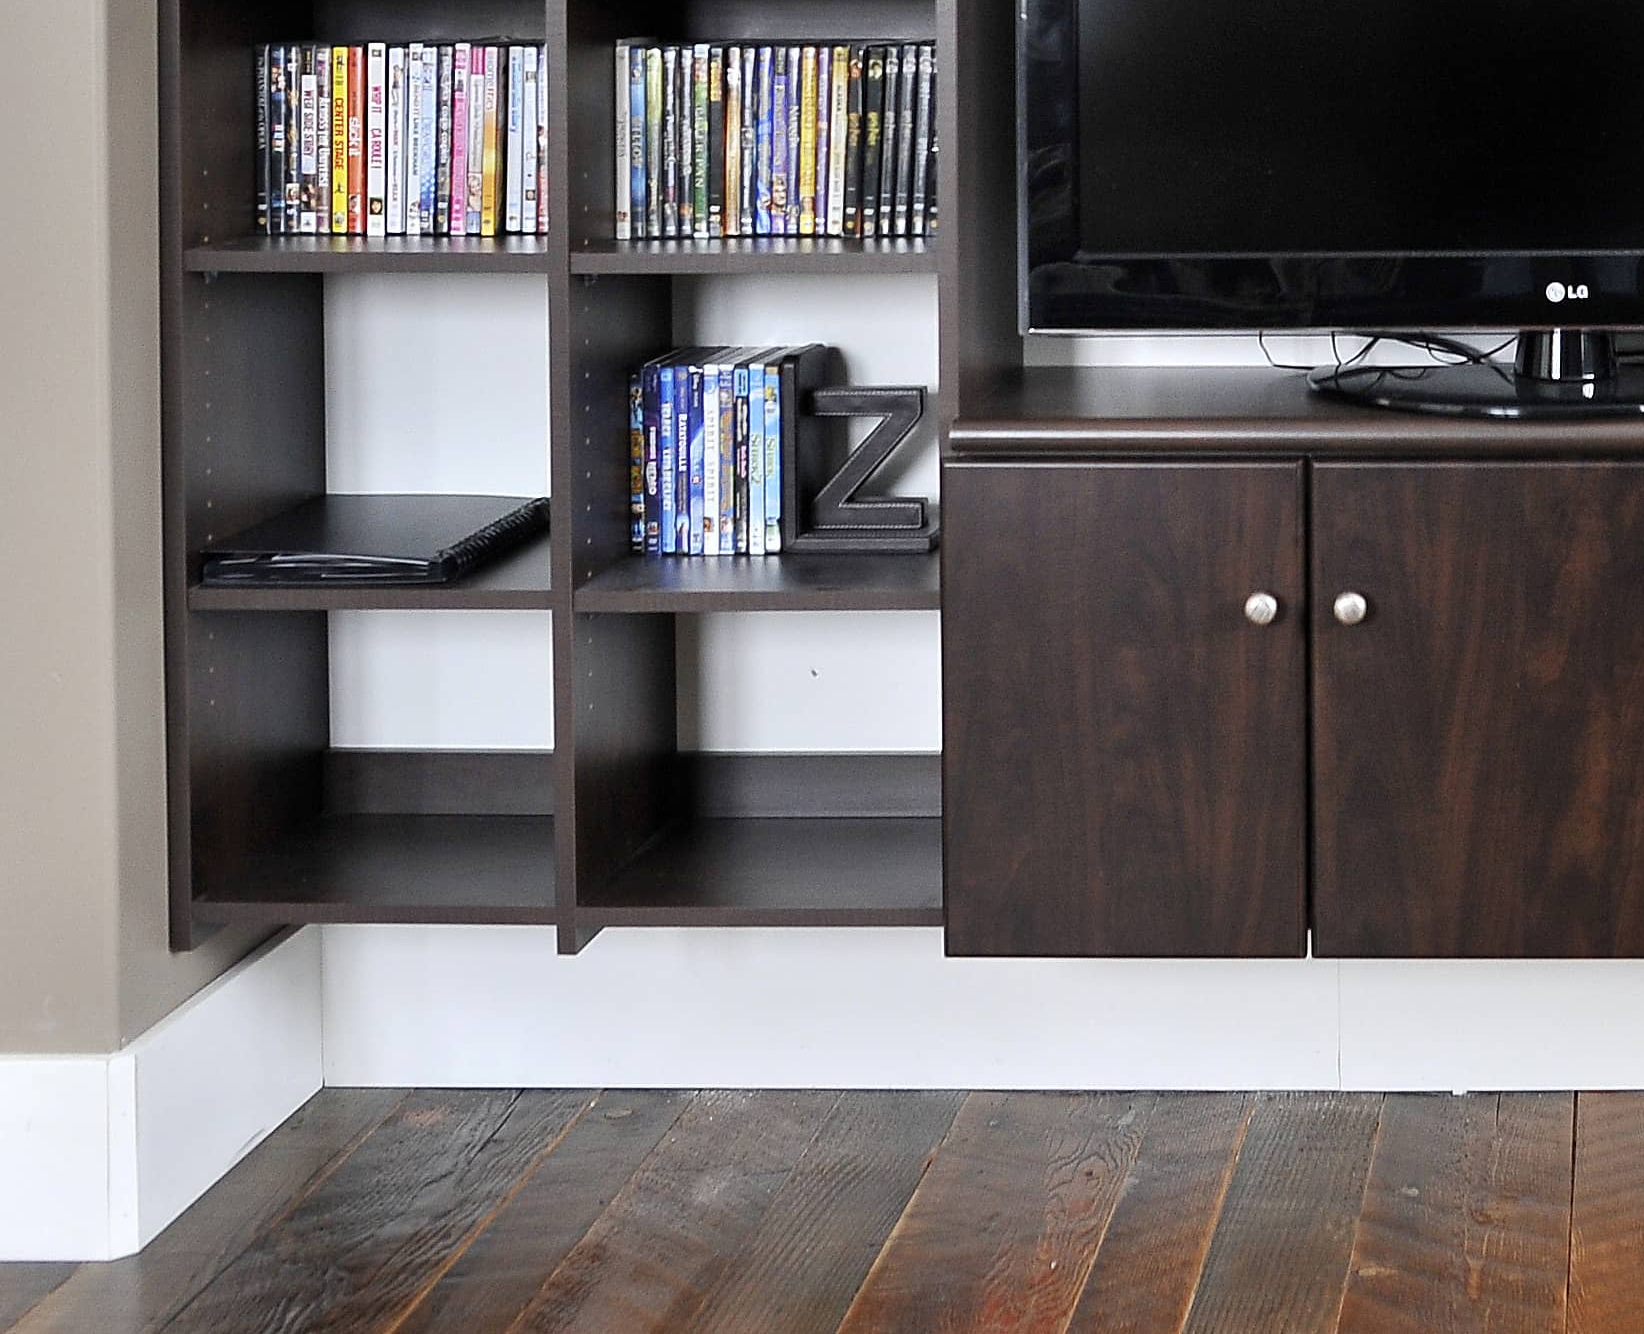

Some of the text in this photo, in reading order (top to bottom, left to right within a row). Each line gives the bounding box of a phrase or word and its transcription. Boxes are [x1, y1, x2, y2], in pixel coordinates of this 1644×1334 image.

[335, 97, 344, 170] CENTER STAGE
[1567, 284, 1589, 299] LG
[751, 474, 762, 484] 2
[812, 385, 927, 530] Z
